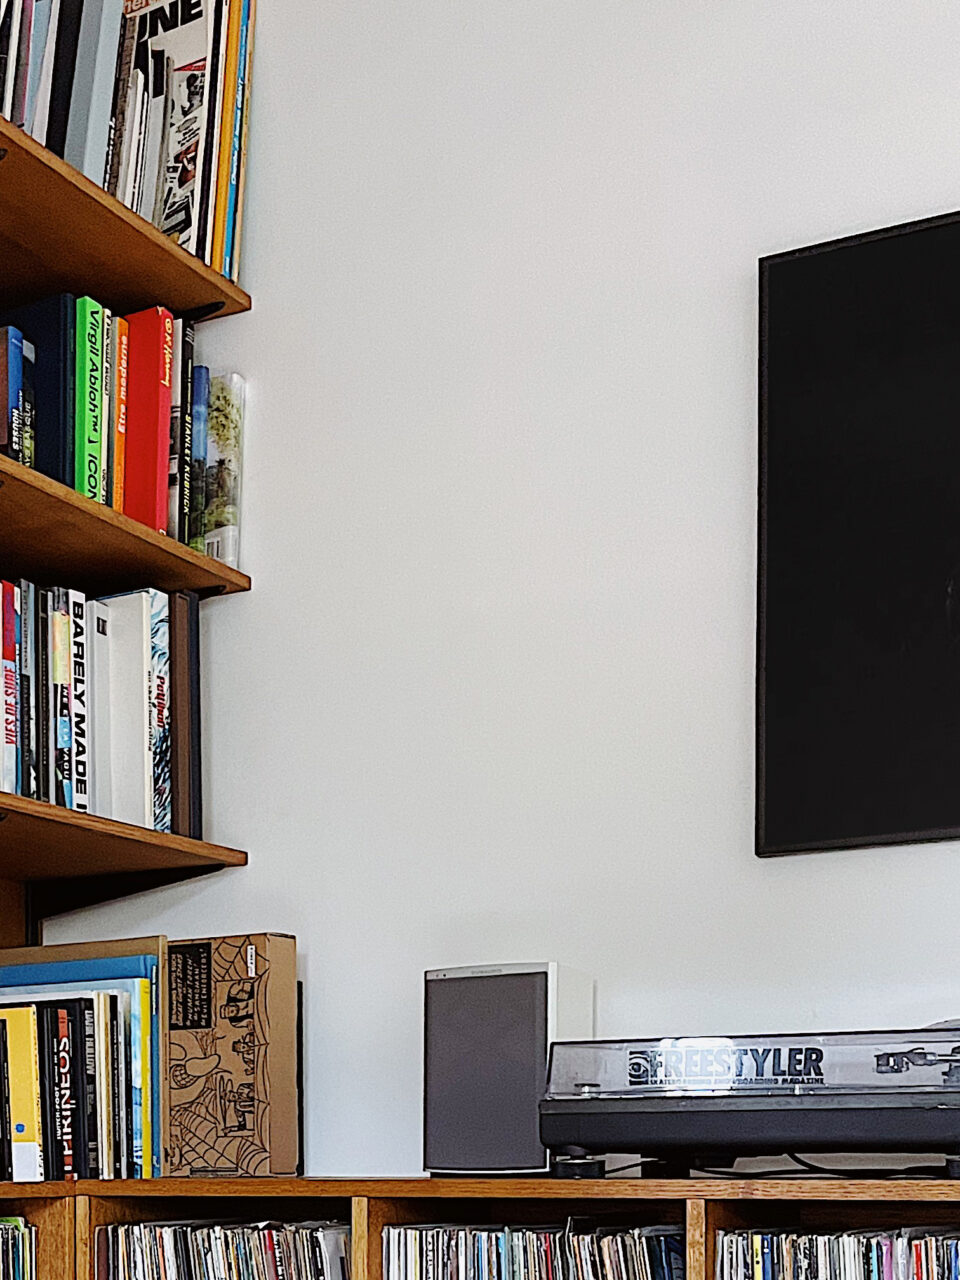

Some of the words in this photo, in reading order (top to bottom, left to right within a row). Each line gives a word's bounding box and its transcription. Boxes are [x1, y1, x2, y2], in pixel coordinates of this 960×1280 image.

[87, 309, 100, 361] Virgil
[118, 335, 128, 407] moderne
[183, 465, 191, 514] KUBRICK
[72, 602, 86, 708] BARELY
[74, 712, 87, 796] MADE
[649, 1047, 824, 1079] FREESTYLER
